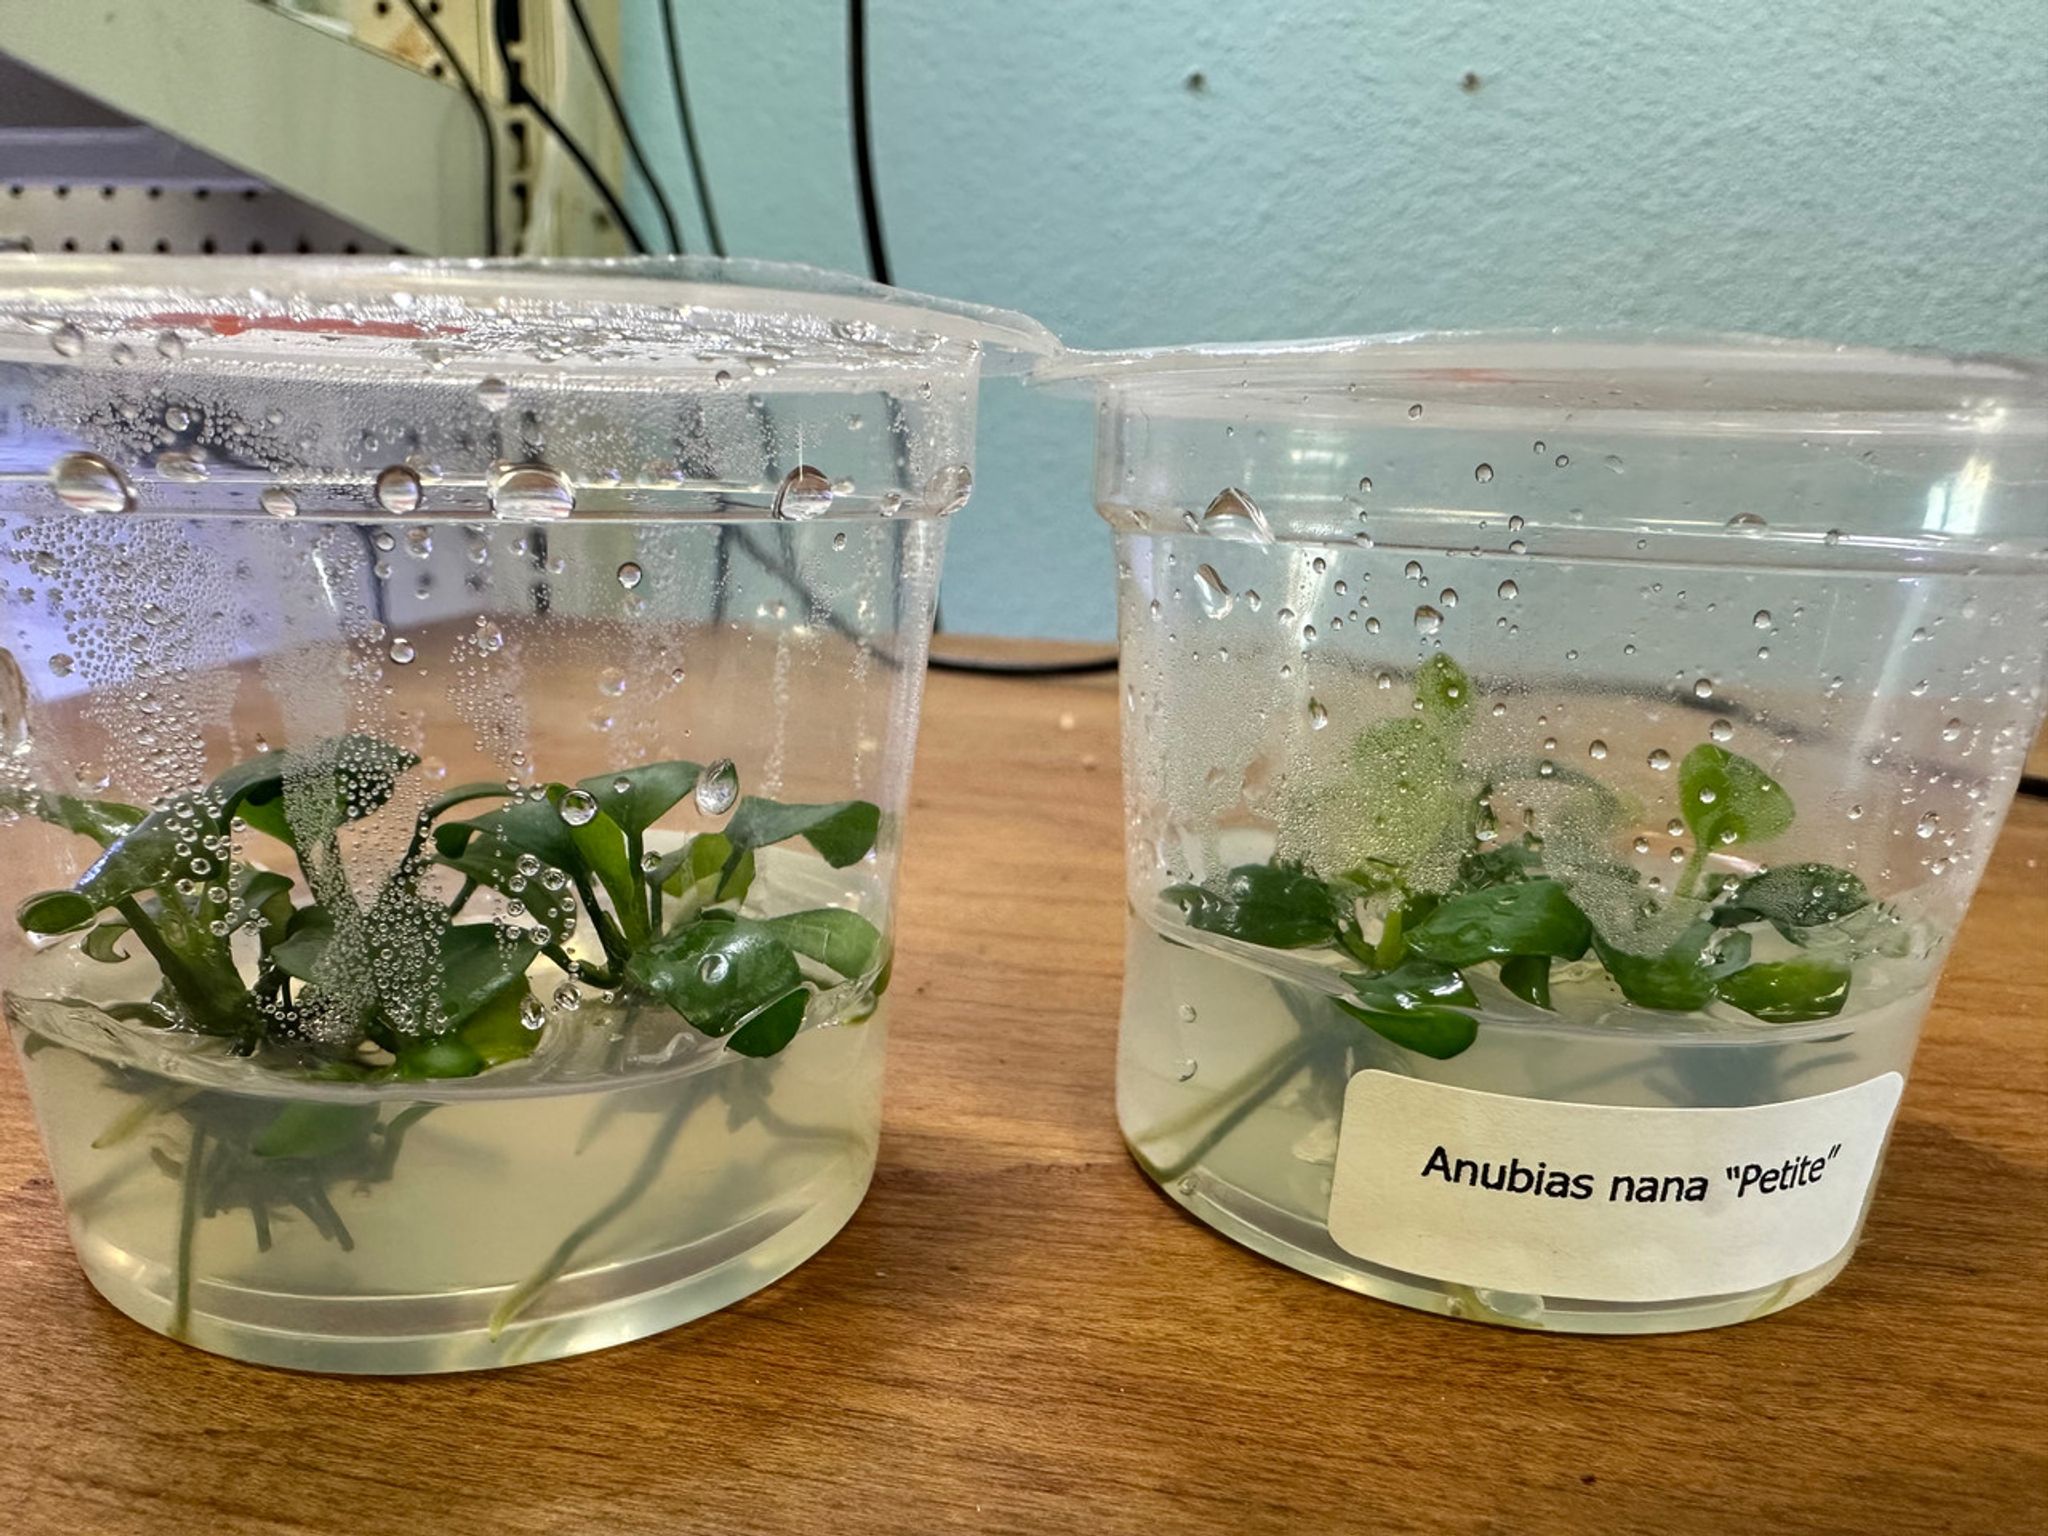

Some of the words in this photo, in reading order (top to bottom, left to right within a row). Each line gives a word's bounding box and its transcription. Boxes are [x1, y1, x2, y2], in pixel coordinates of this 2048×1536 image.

[1420, 1144, 1595, 1200] Anubias
[1608, 1175, 1709, 1203] nana
[1725, 1143, 1842, 1198] "Petite"
